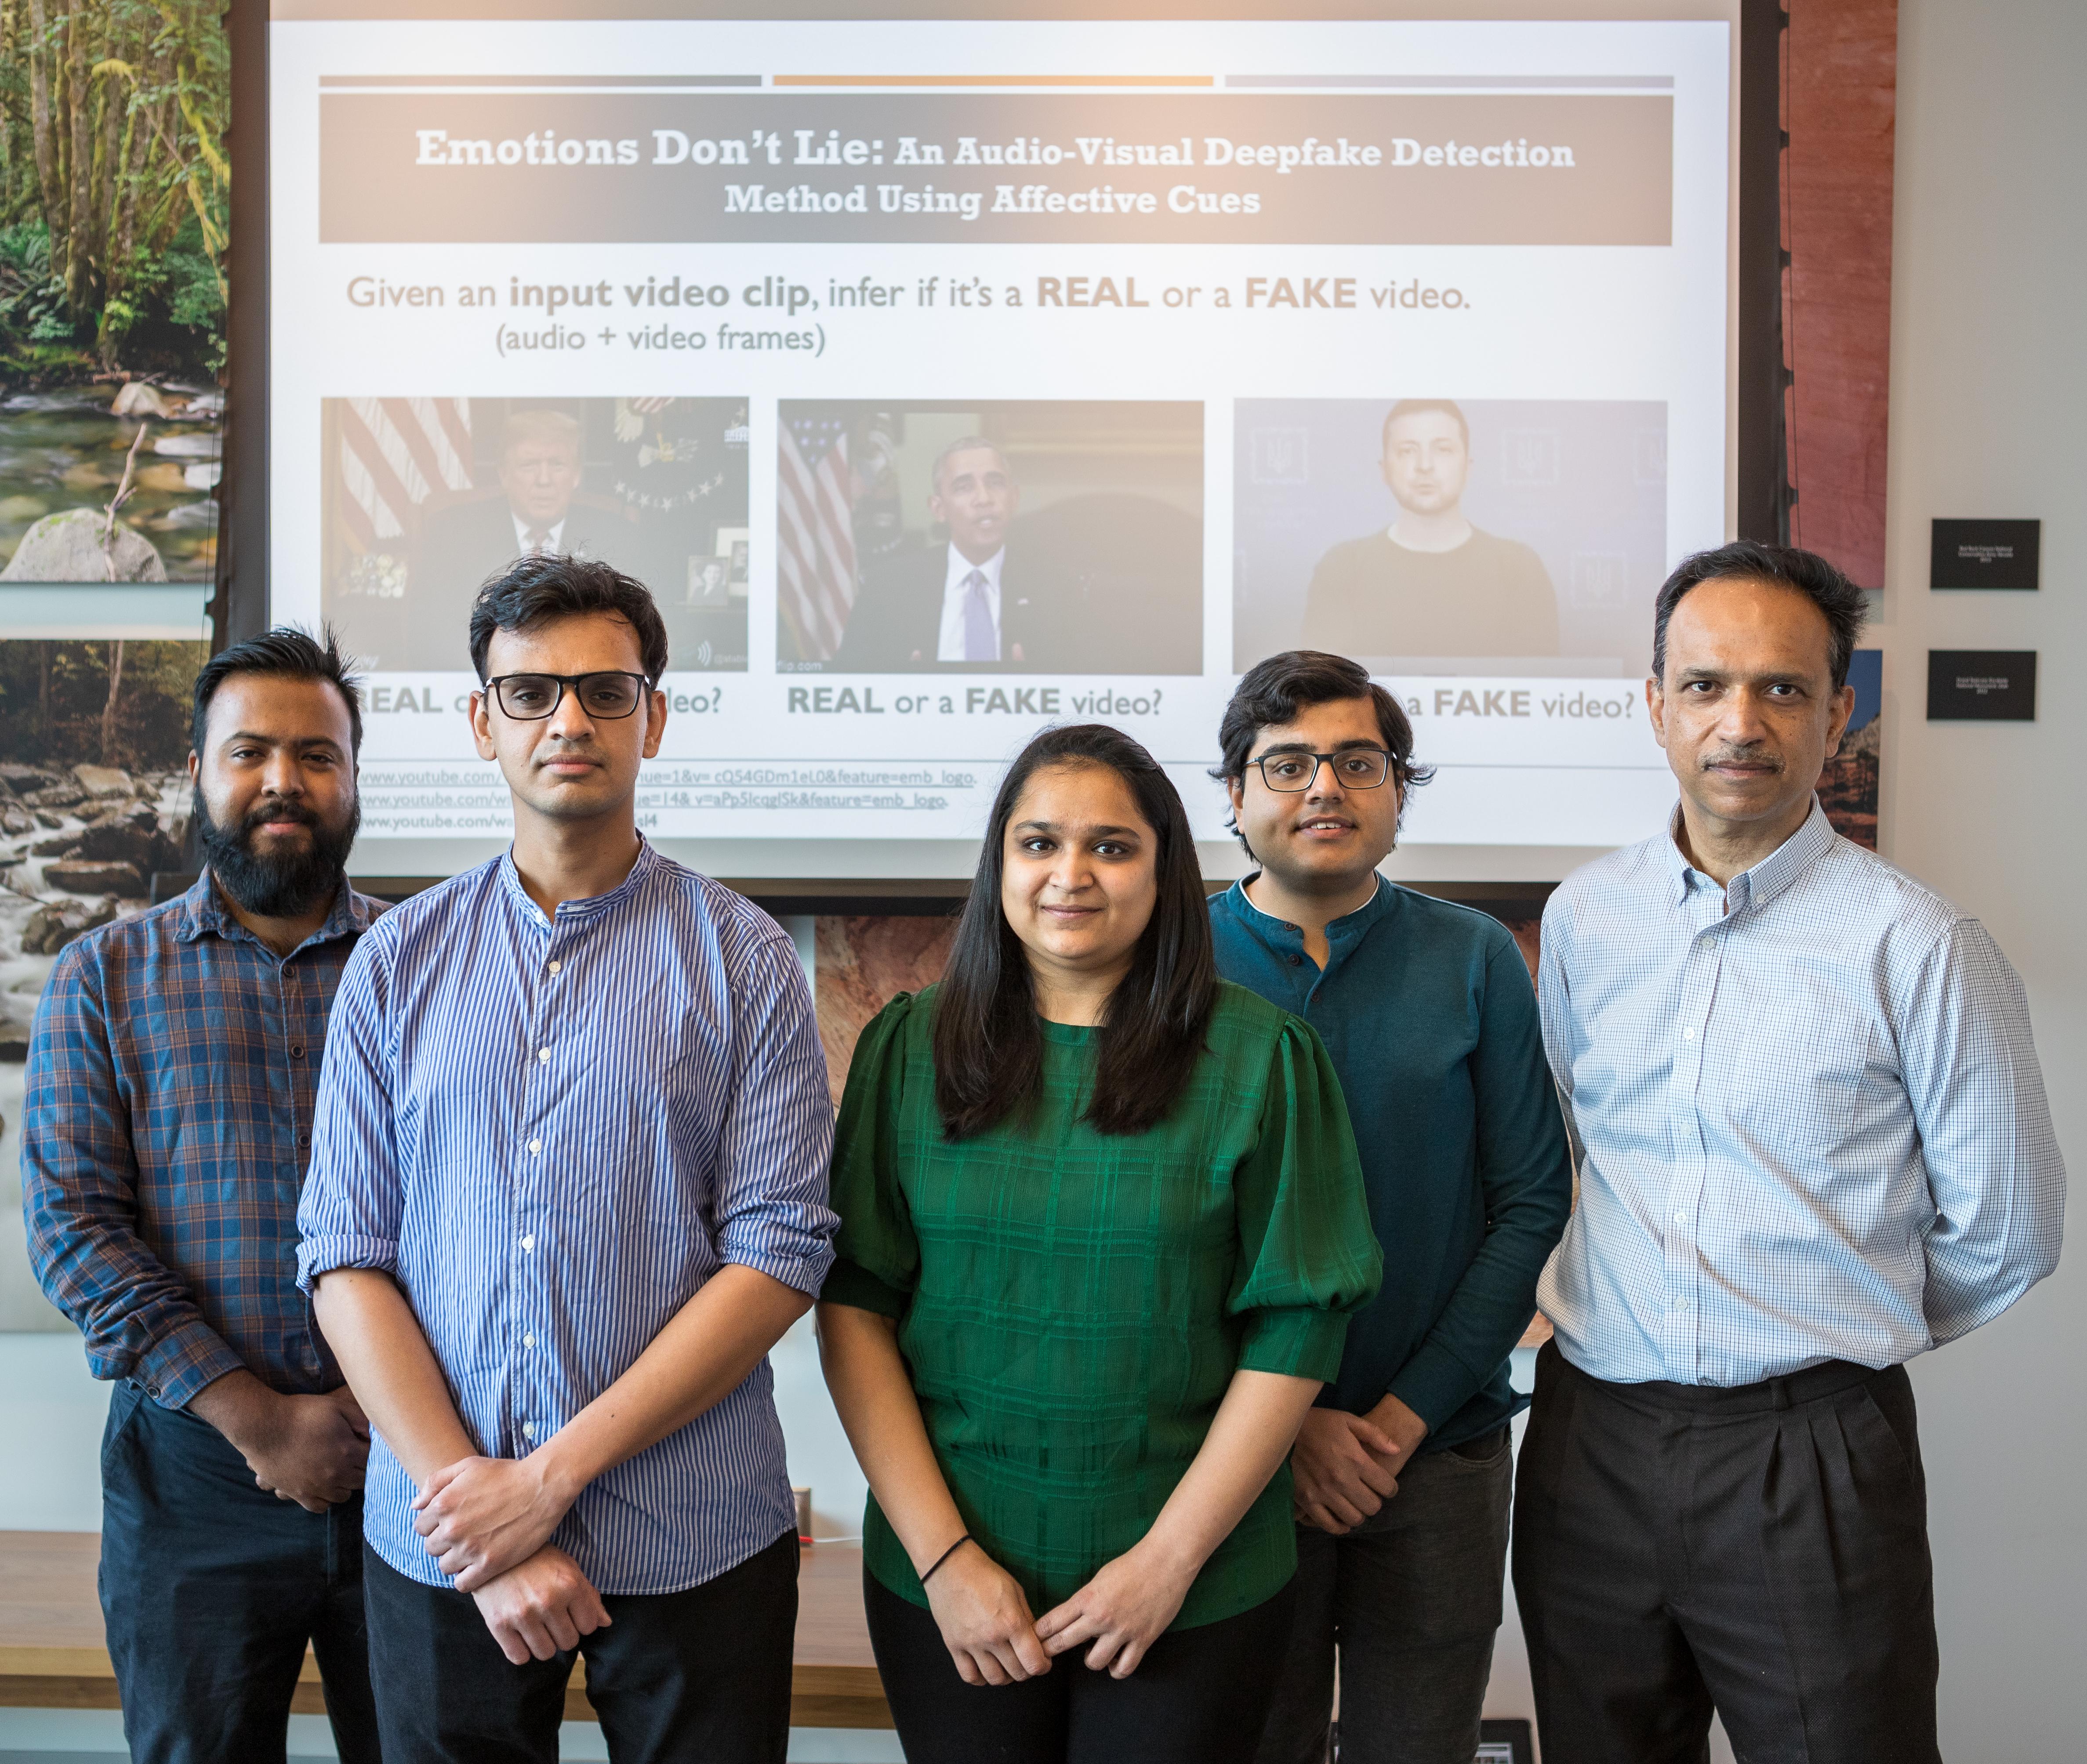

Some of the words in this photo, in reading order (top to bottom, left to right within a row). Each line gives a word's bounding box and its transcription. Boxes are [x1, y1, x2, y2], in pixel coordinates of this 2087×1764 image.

[415, 129, 639, 166] Emotions
[652, 130, 781, 165] Don't
[794, 130, 883, 165] Lie:
[893, 137, 945, 165] An
[953, 137, 1195, 167] Audio-Visual
[1203, 137, 1382, 174] Deepfake
[1391, 138, 1575, 167] Detection
[724, 185, 868, 213] Method
[877, 185, 983, 221] Using
[991, 185, 1158, 214] Affective
[1167, 185, 1260, 214] Cues
[347, 276, 444, 307] Given
[458, 286, 496, 307] an
[511, 276, 613, 316] input
[624, 276, 730, 307] video
[743, 276, 819, 316] clip,
[830, 276, 905, 307] infer
[918, 276, 939, 307] if
[950, 276, 992, 307] it's
[1005, 286, 1023, 307] a
[1038, 276, 1149, 307] REAL
[1162, 287, 1202, 308] or
[1214, 287, 1231, 308] a
[1246, 277, 1357, 308] FAKE
[1370, 278, 1470, 309] video.
[496, 323, 586, 357] (audio
[598, 327, 617, 345] +
[628, 323, 706, 350] video
[717, 323, 825, 358] frames)
[788, 687, 885, 714] REAL
[895, 695, 929, 714] or
[939, 695, 954, 714] a
[966, 688, 1060, 715] FAKE
[1071, 688, 1162, 716] video?
[1408, 697, 1423, 716] a
[1434, 689, 1531, 717] FAKE
[1542, 691, 1635, 719] video?
